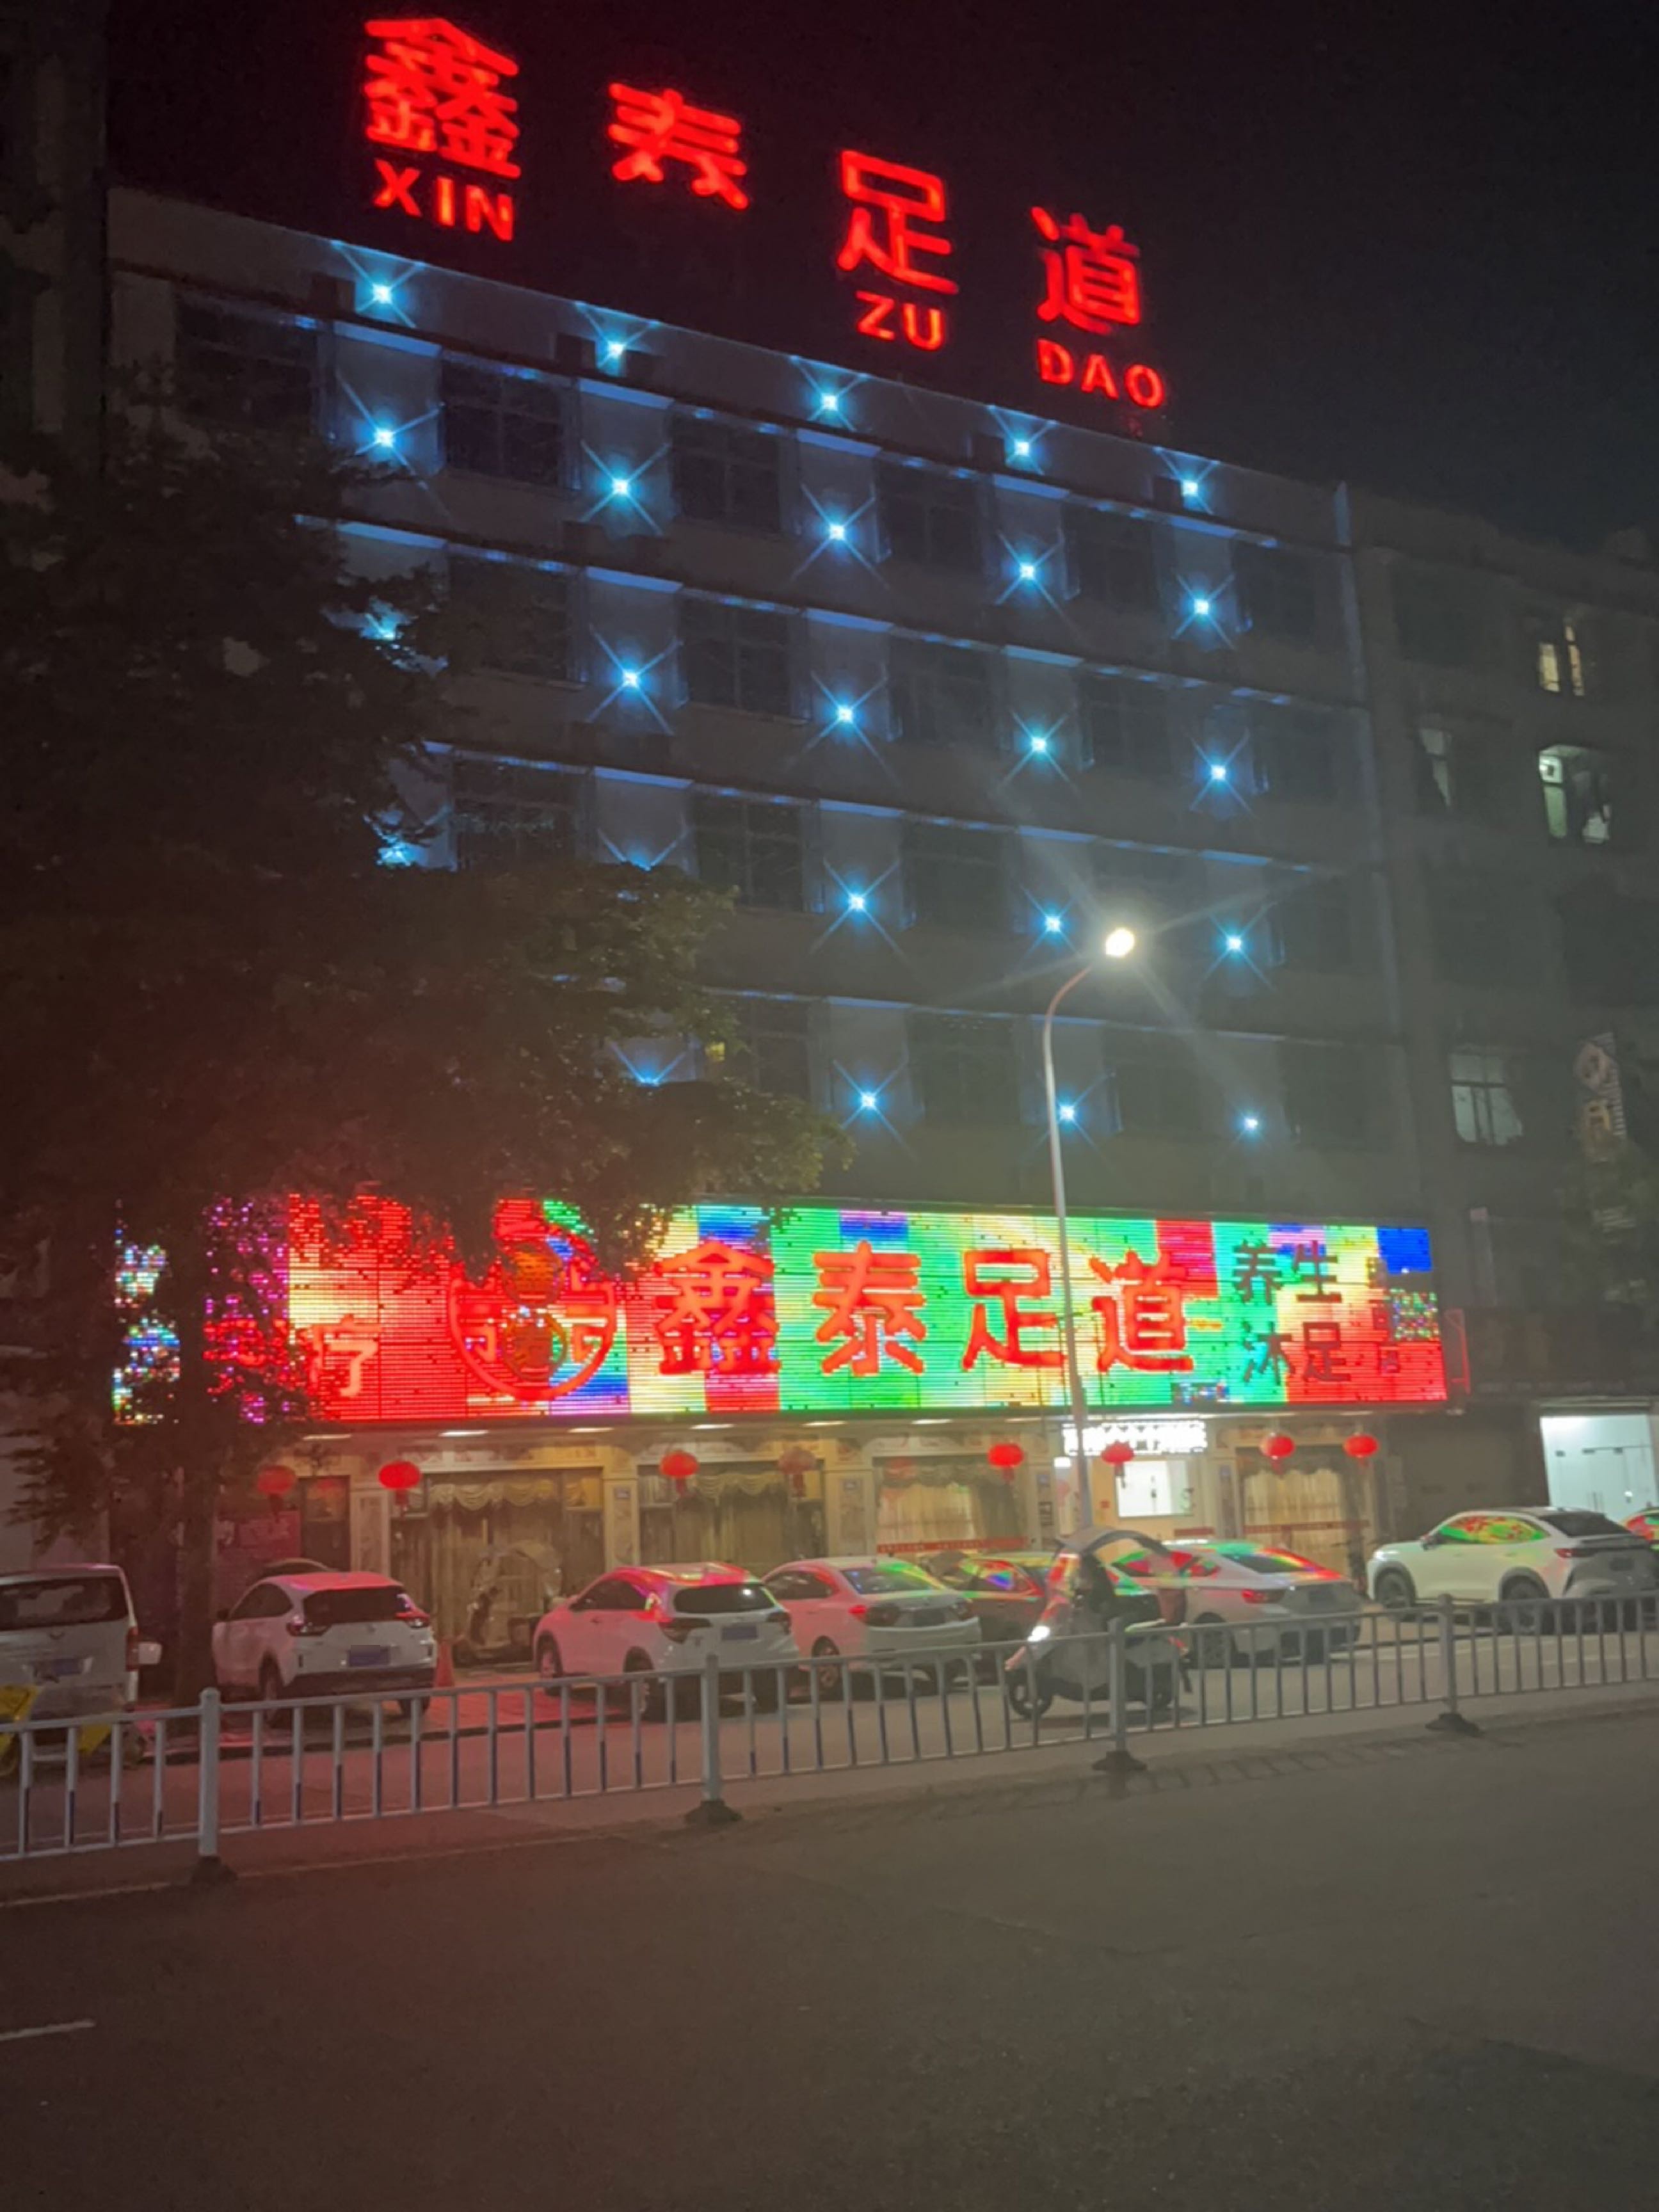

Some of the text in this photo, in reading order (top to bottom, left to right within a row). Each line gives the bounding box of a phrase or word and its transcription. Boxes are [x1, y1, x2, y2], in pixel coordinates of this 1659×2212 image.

[373, 158, 1166, 408] XIN ZU DAO
[653, 1238, 1194, 1376] 鑫泰足道
[1233, 1238, 1342, 1306] 养生
[1242, 1320, 1352, 1386] 沐足
